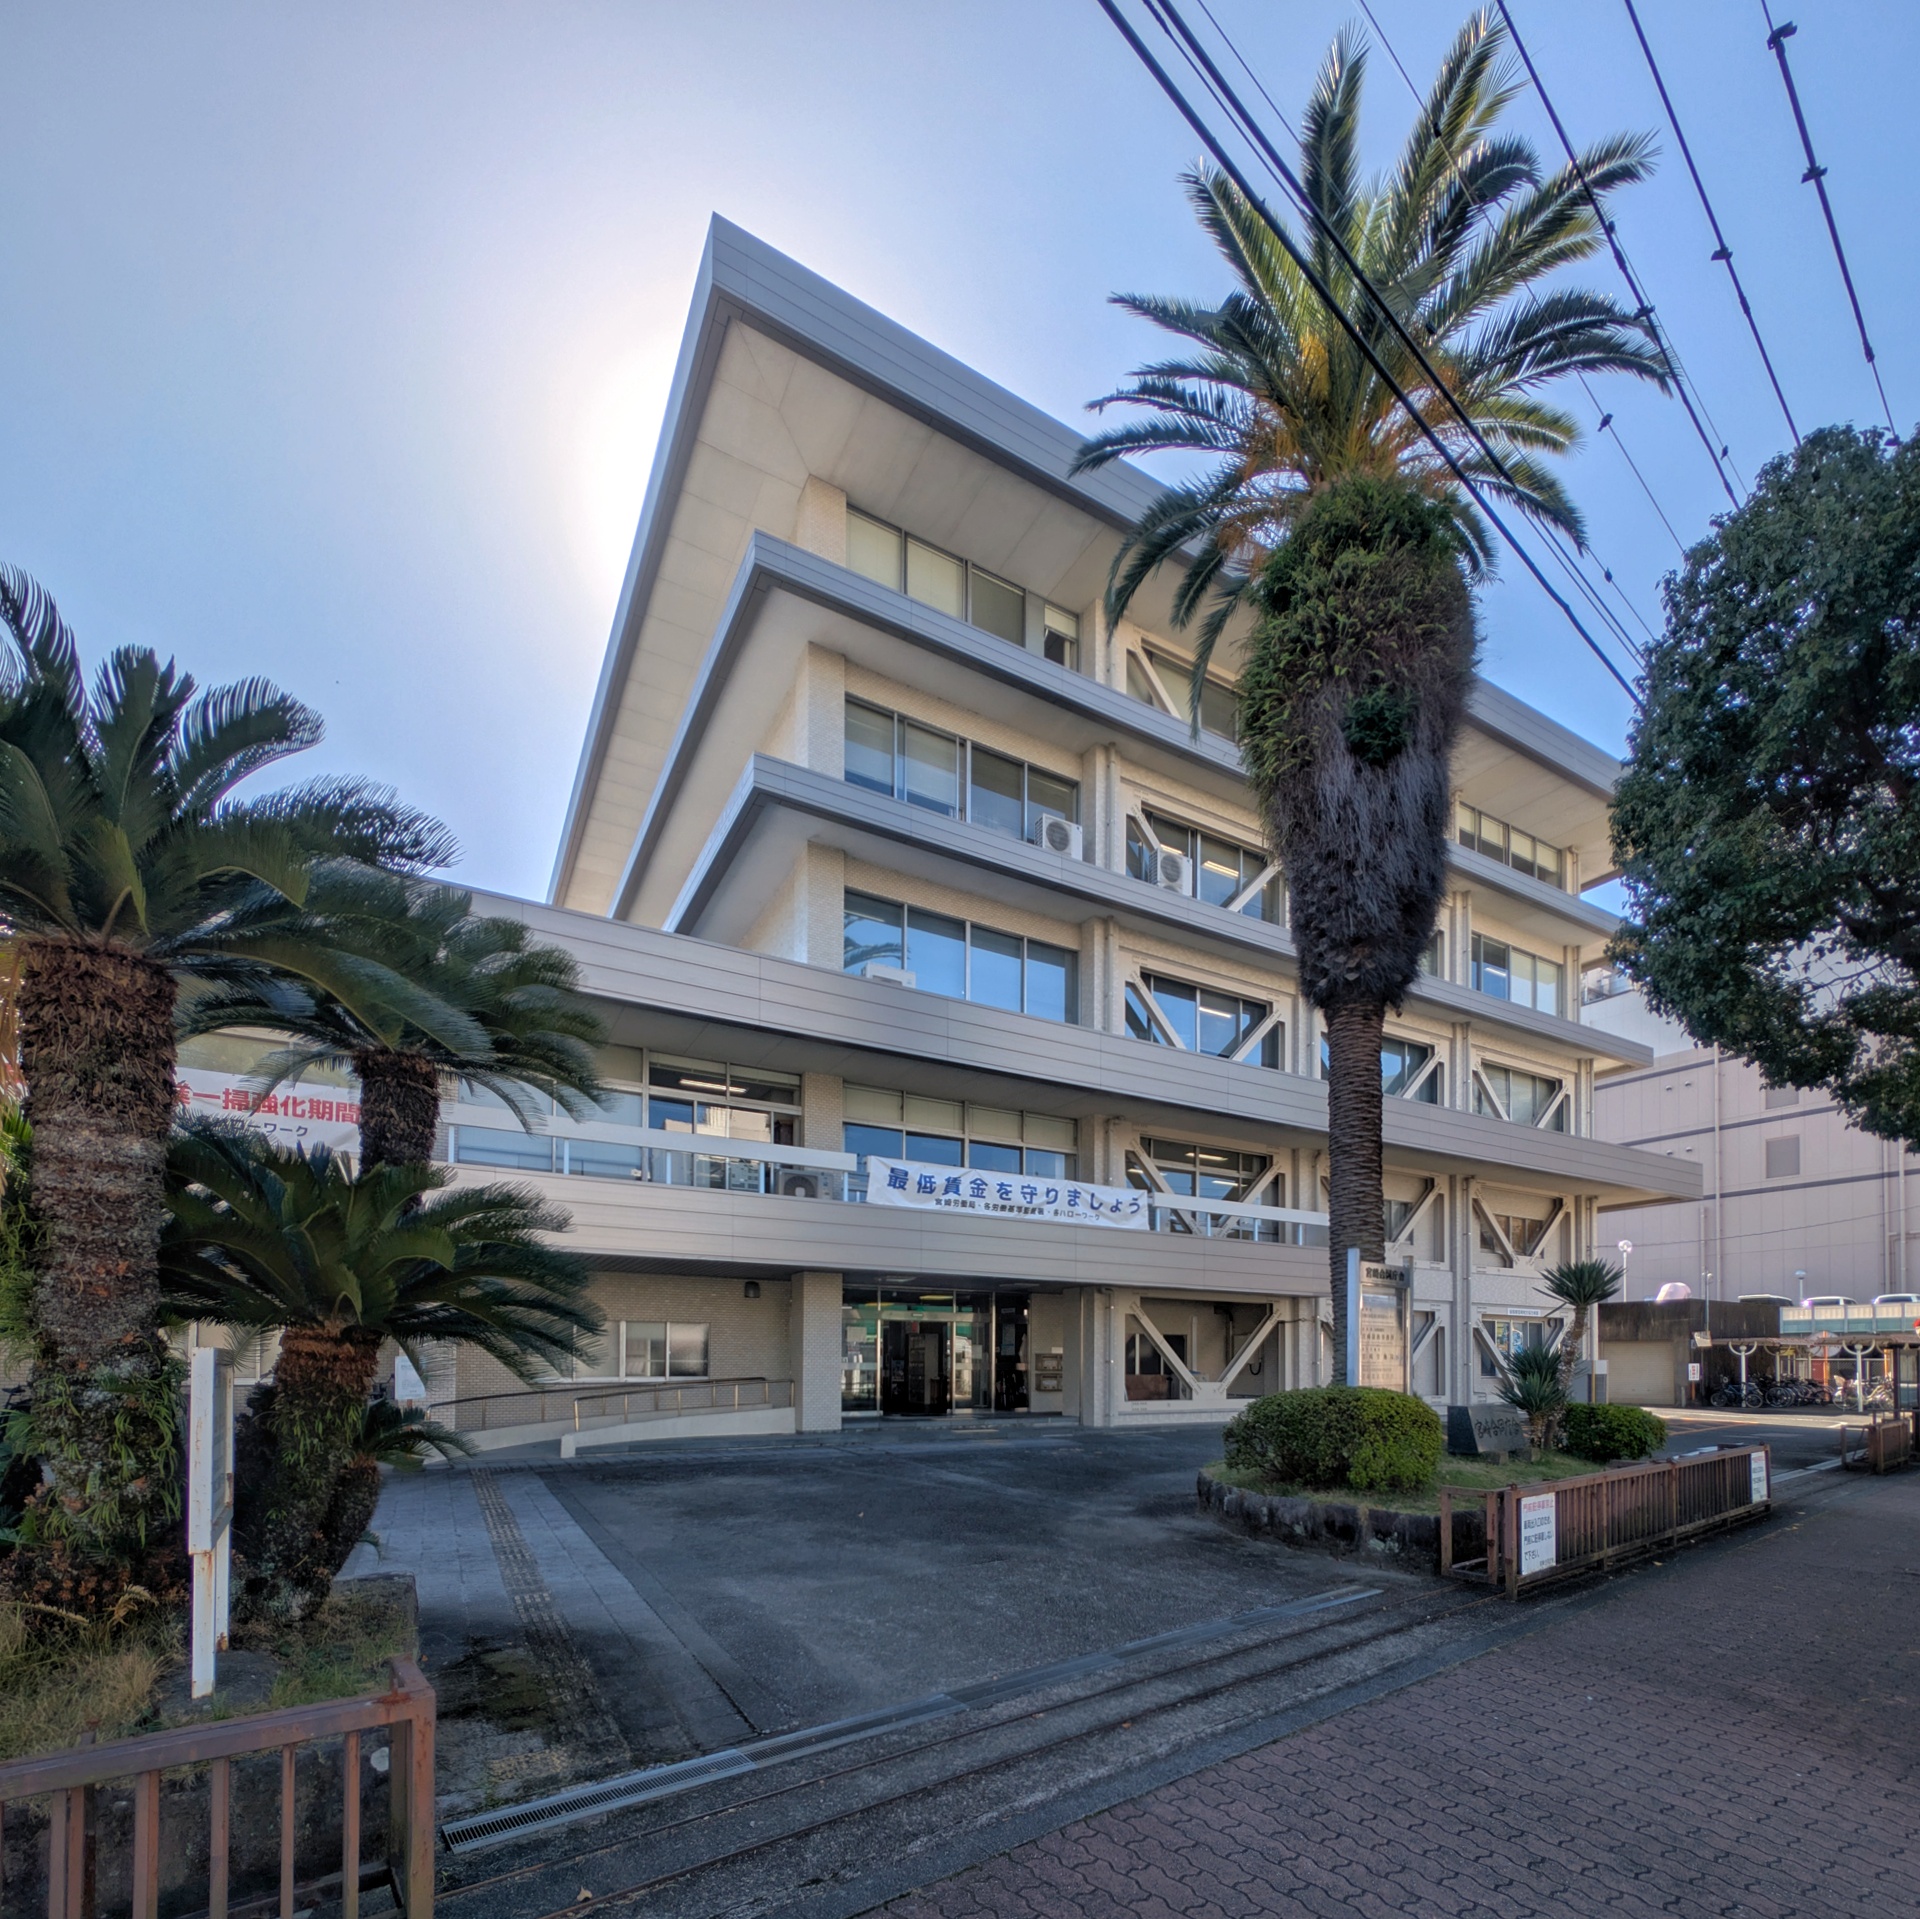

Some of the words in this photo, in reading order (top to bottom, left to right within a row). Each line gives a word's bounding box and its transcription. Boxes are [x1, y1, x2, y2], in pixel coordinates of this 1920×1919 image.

[887, 1167, 1141, 1214] 最低賃金を守りましょう
